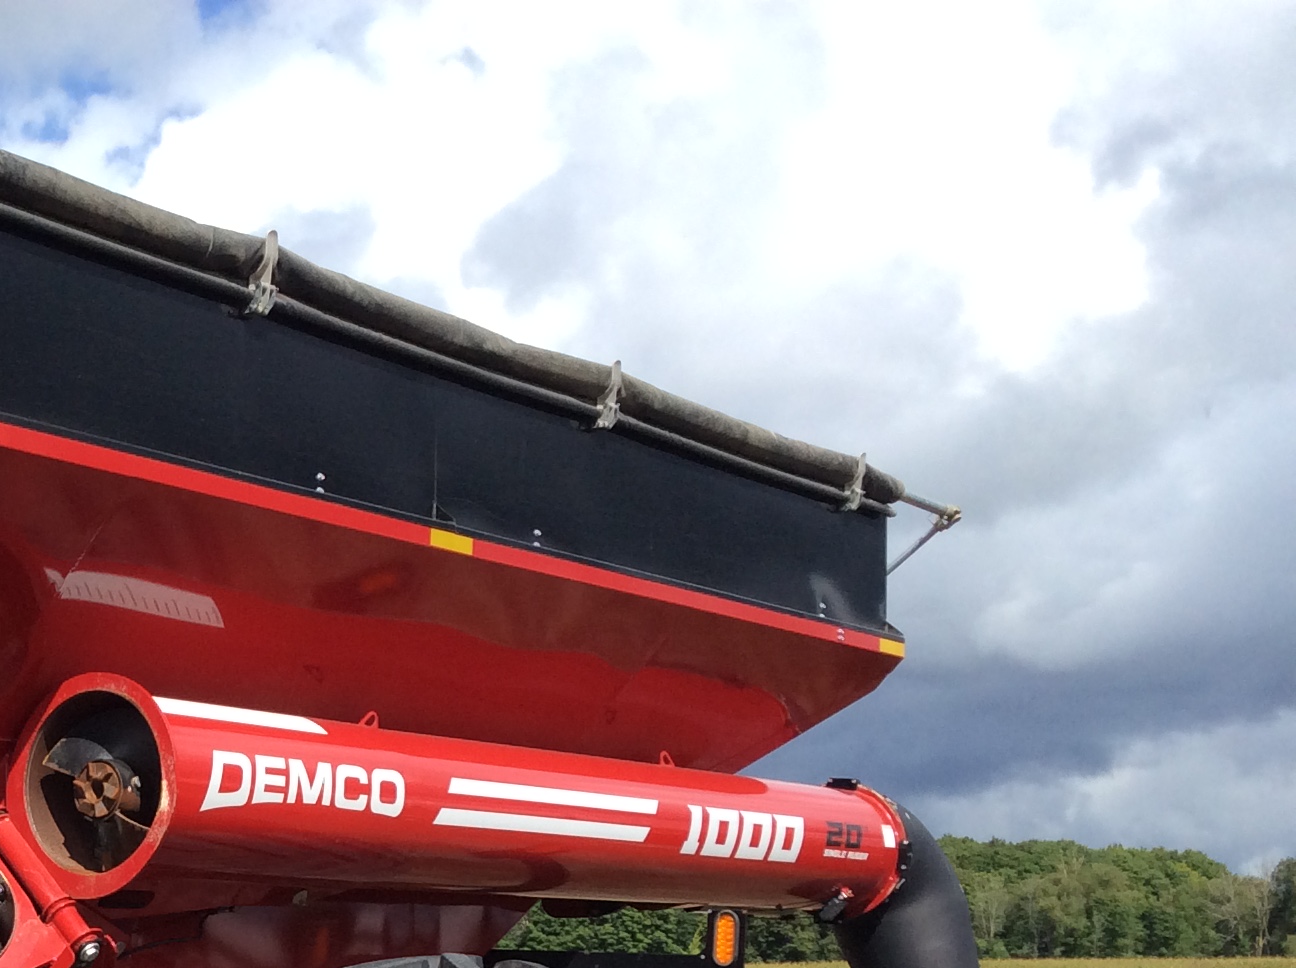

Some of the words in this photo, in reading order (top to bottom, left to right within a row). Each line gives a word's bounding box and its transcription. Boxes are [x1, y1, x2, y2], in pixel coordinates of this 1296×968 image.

[200, 749, 406, 818] DEMCO
[680, 804, 805, 863] 1000
[826, 821, 862, 849] 20
